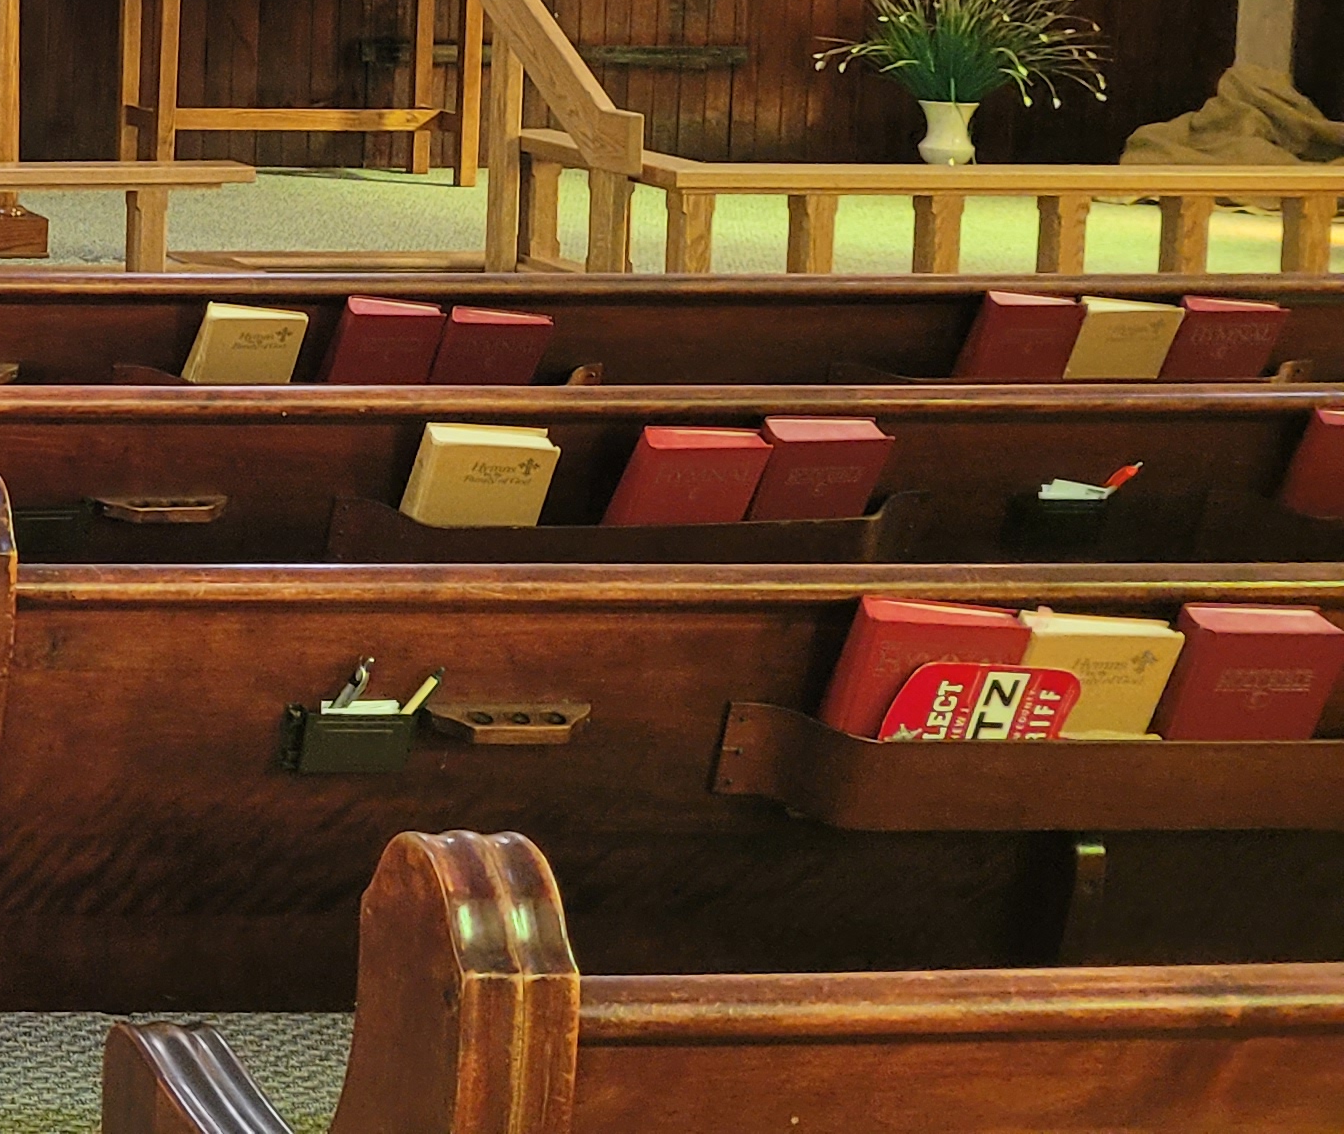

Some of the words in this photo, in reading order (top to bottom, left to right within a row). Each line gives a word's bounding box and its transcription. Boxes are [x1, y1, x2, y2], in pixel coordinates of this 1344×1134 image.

[922, 680, 964, 740] LECT
[972, 680, 1020, 740] TZ
[1025, 689, 1061, 740] RIFF
